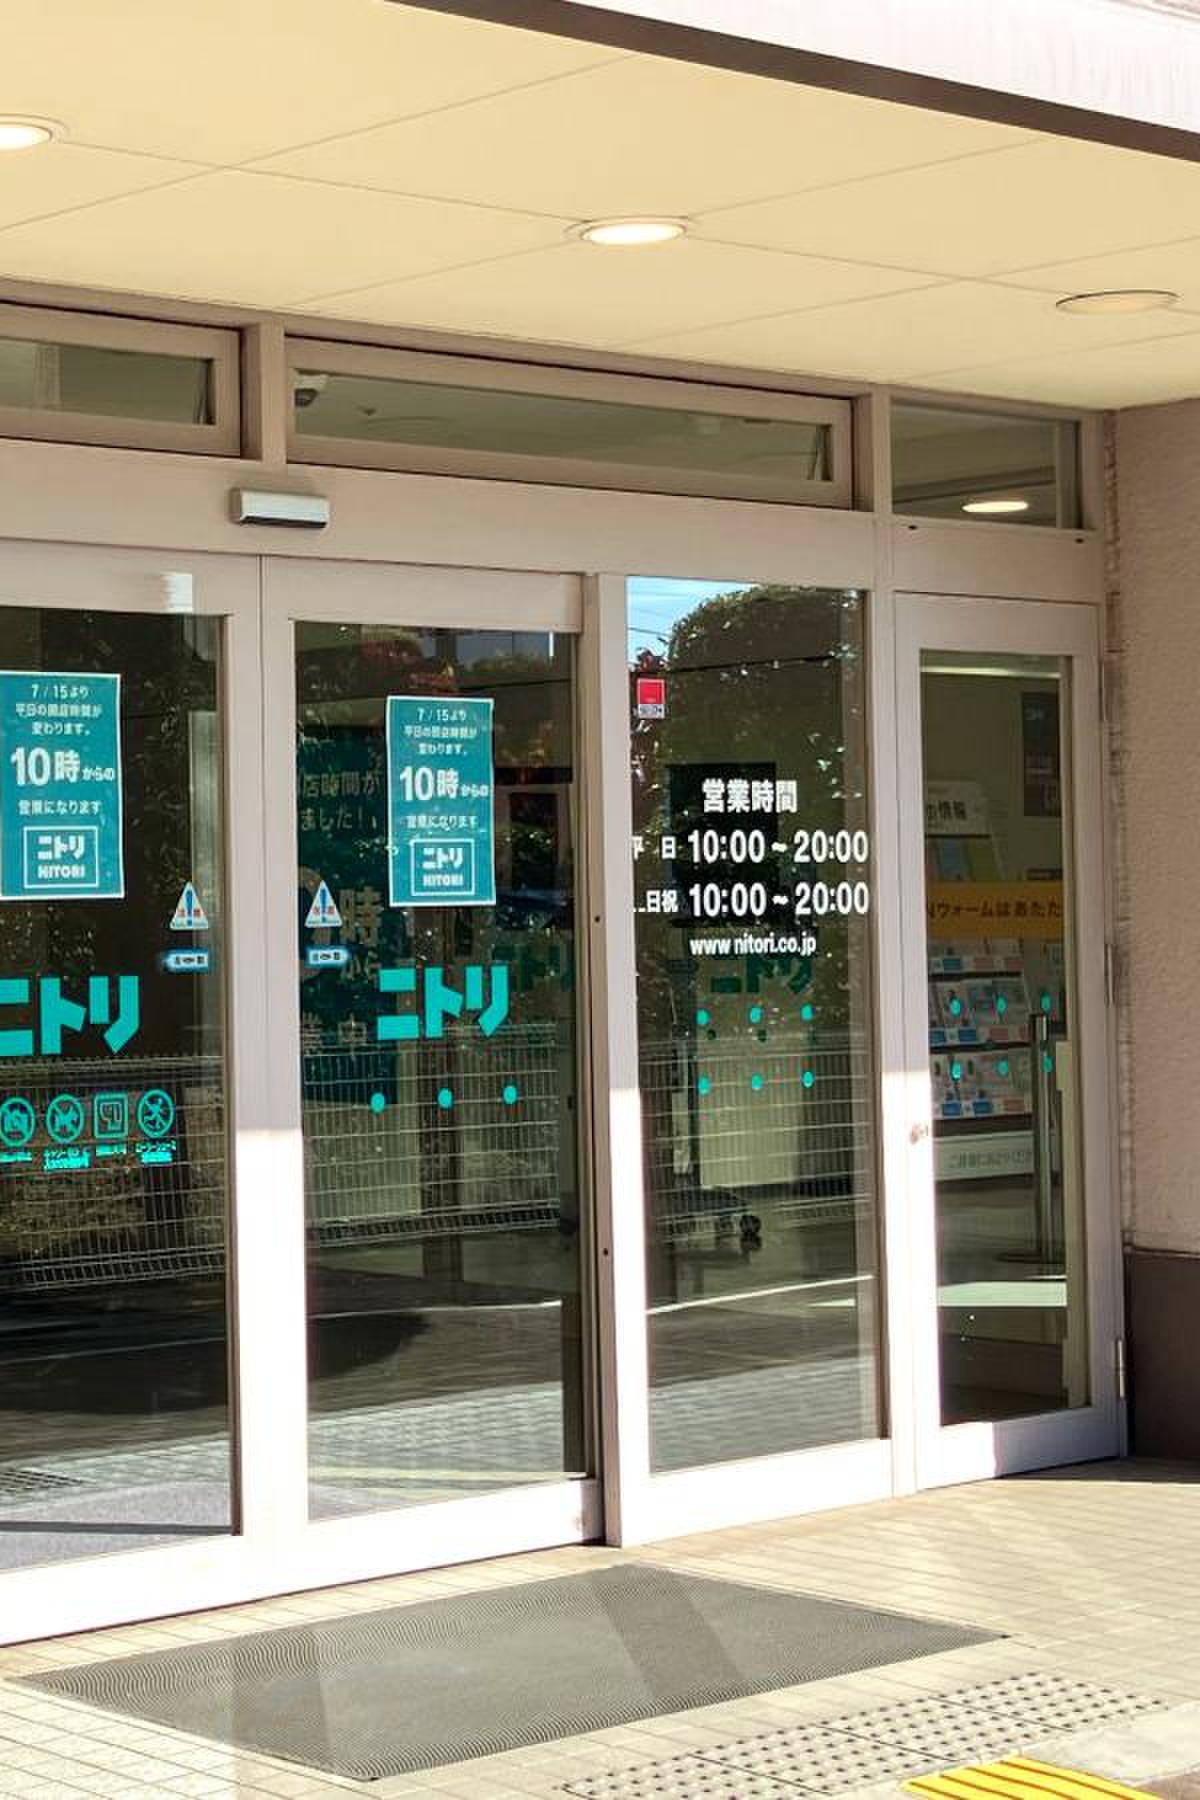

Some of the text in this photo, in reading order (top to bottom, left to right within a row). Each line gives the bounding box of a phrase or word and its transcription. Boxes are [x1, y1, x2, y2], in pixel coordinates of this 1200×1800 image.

[702, 779, 798, 813] 営業時間
[37, 835, 86, 861] ニトリ
[422, 847, 463, 869] ニトリ
[38, 865, 86, 880] NITORI
[632, 889, 679, 913] 日祝
[689, 932, 817, 956] www.nitori.co.jp
[377, 965, 509, 1040] ニトリ
